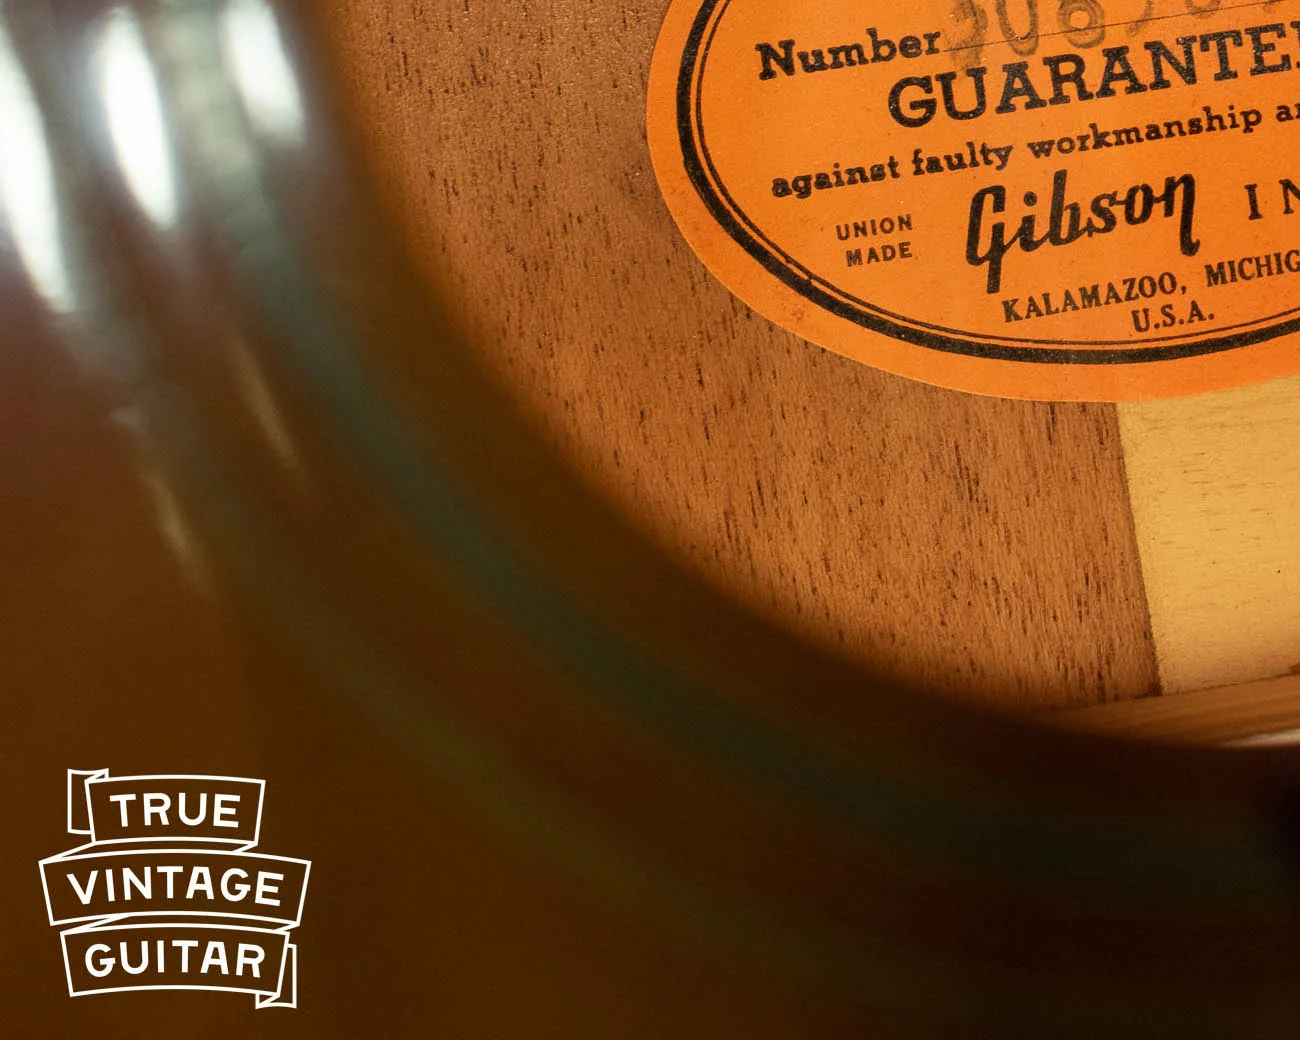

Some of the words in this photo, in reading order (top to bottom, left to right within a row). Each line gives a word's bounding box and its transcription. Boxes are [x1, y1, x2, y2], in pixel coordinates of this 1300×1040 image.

[755, 27, 942, 81] Number
[771, 155, 902, 199] against
[911, 138, 1013, 177] faulty
[1027, 103, 1262, 160] workmanship
[835, 213, 914, 242] UNION
[964, 169, 1202, 294] Gibson
[845, 241, 913, 268] MADE
[1001, 271, 1188, 324] KALAMAZOO,
[1131, 303, 1216, 333] U.S.A.
